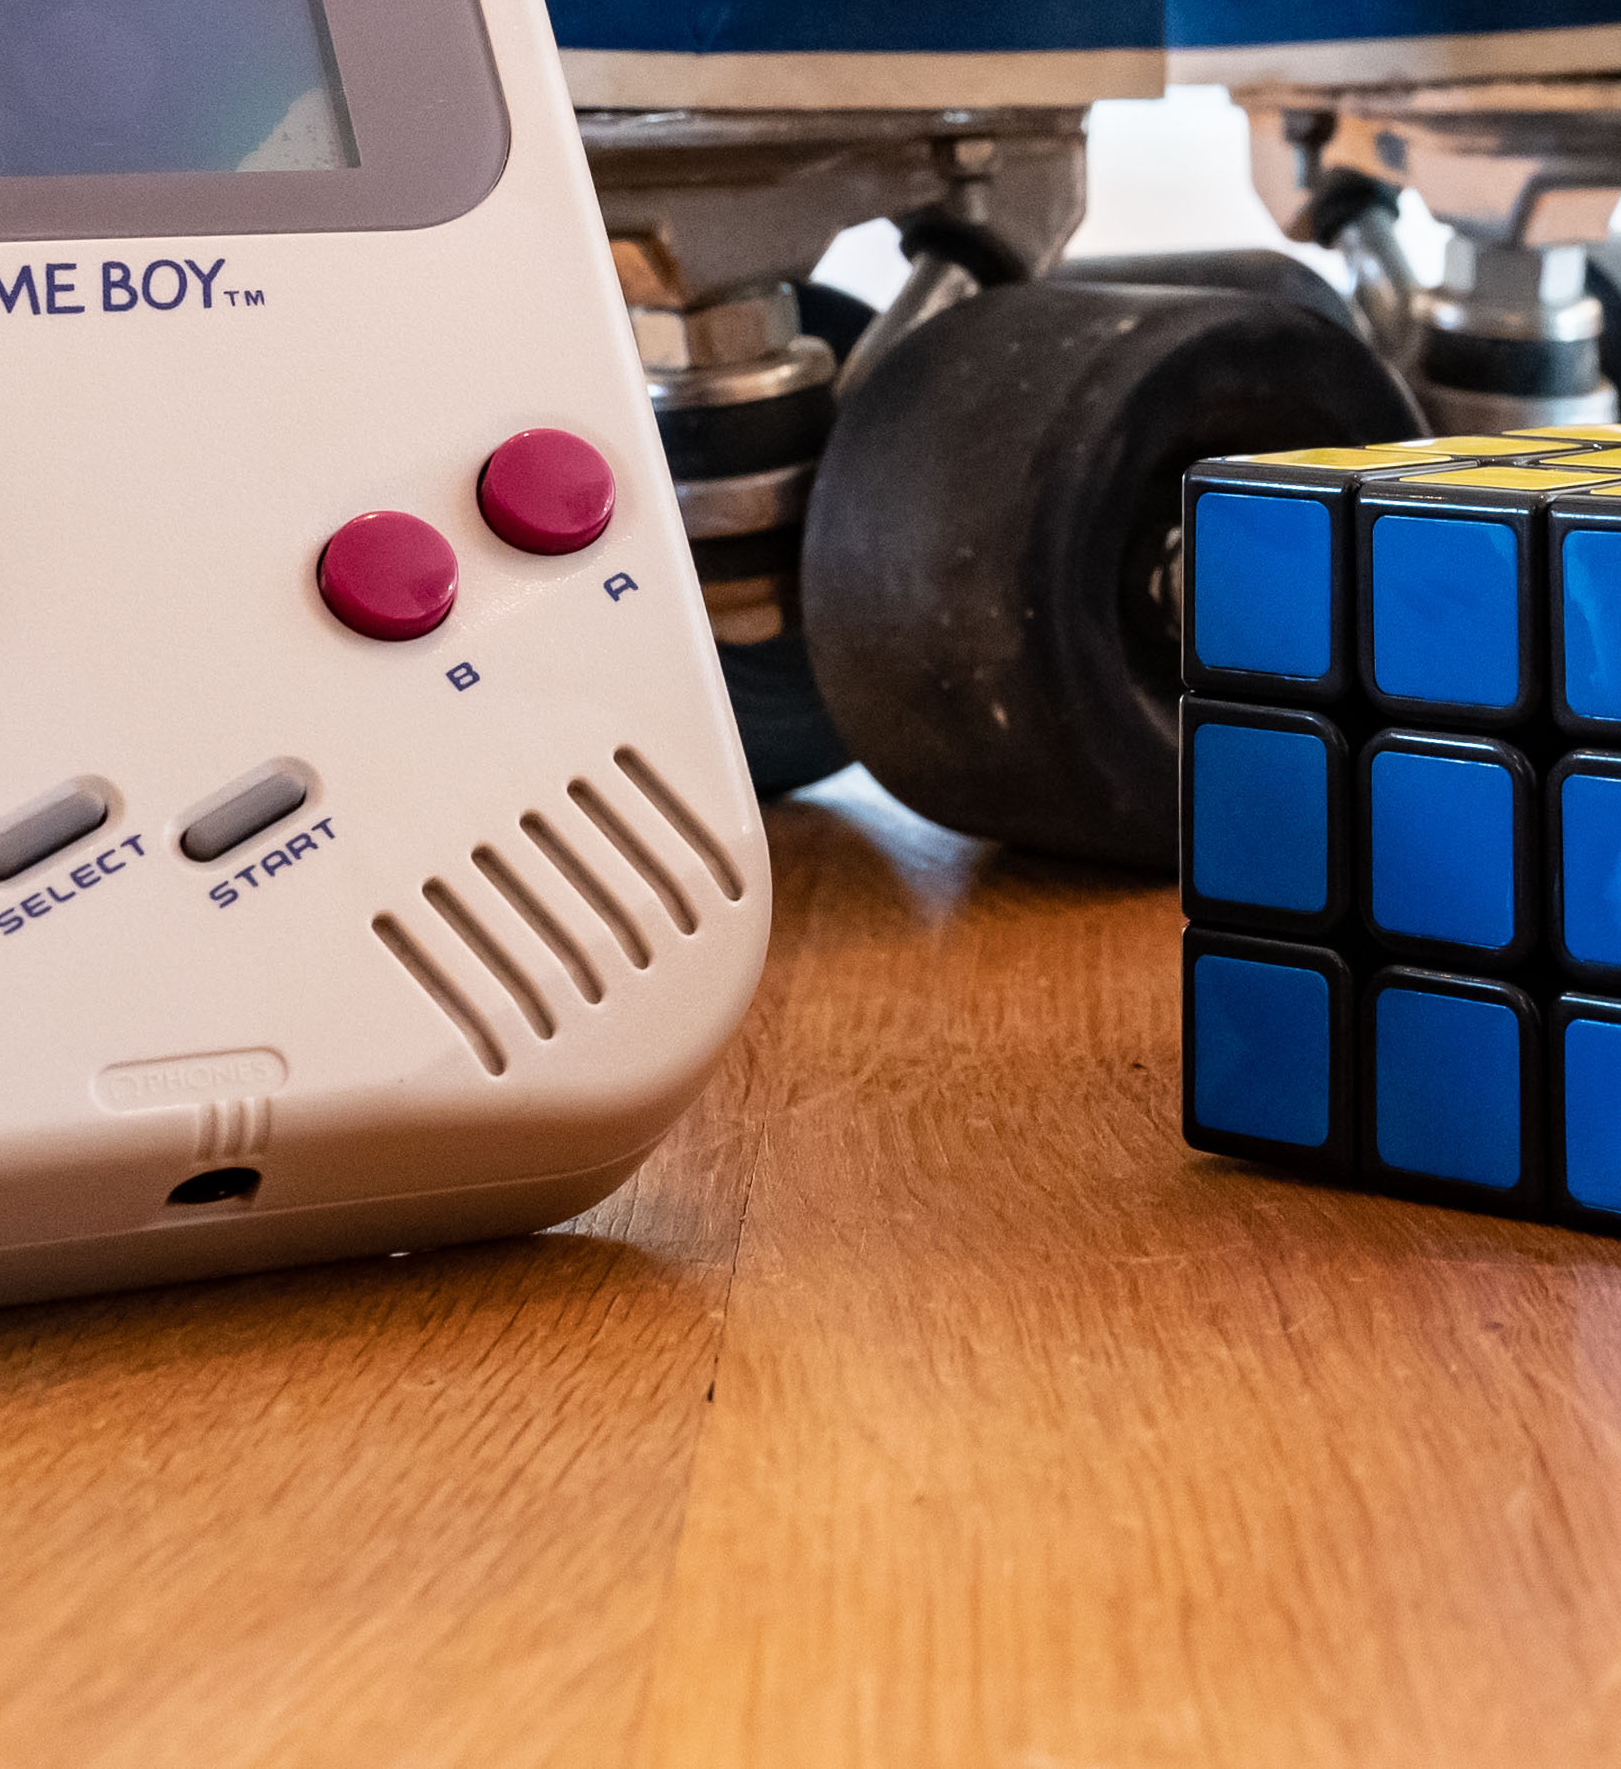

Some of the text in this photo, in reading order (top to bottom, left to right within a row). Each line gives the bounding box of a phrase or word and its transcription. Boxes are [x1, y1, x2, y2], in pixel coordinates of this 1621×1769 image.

[101, 258, 226, 313] BOY
[603, 572, 639, 602] A
[446, 662, 480, 692] B
[208, 817, 338, 909] START
[143, 1055, 271, 1093] PHONES
